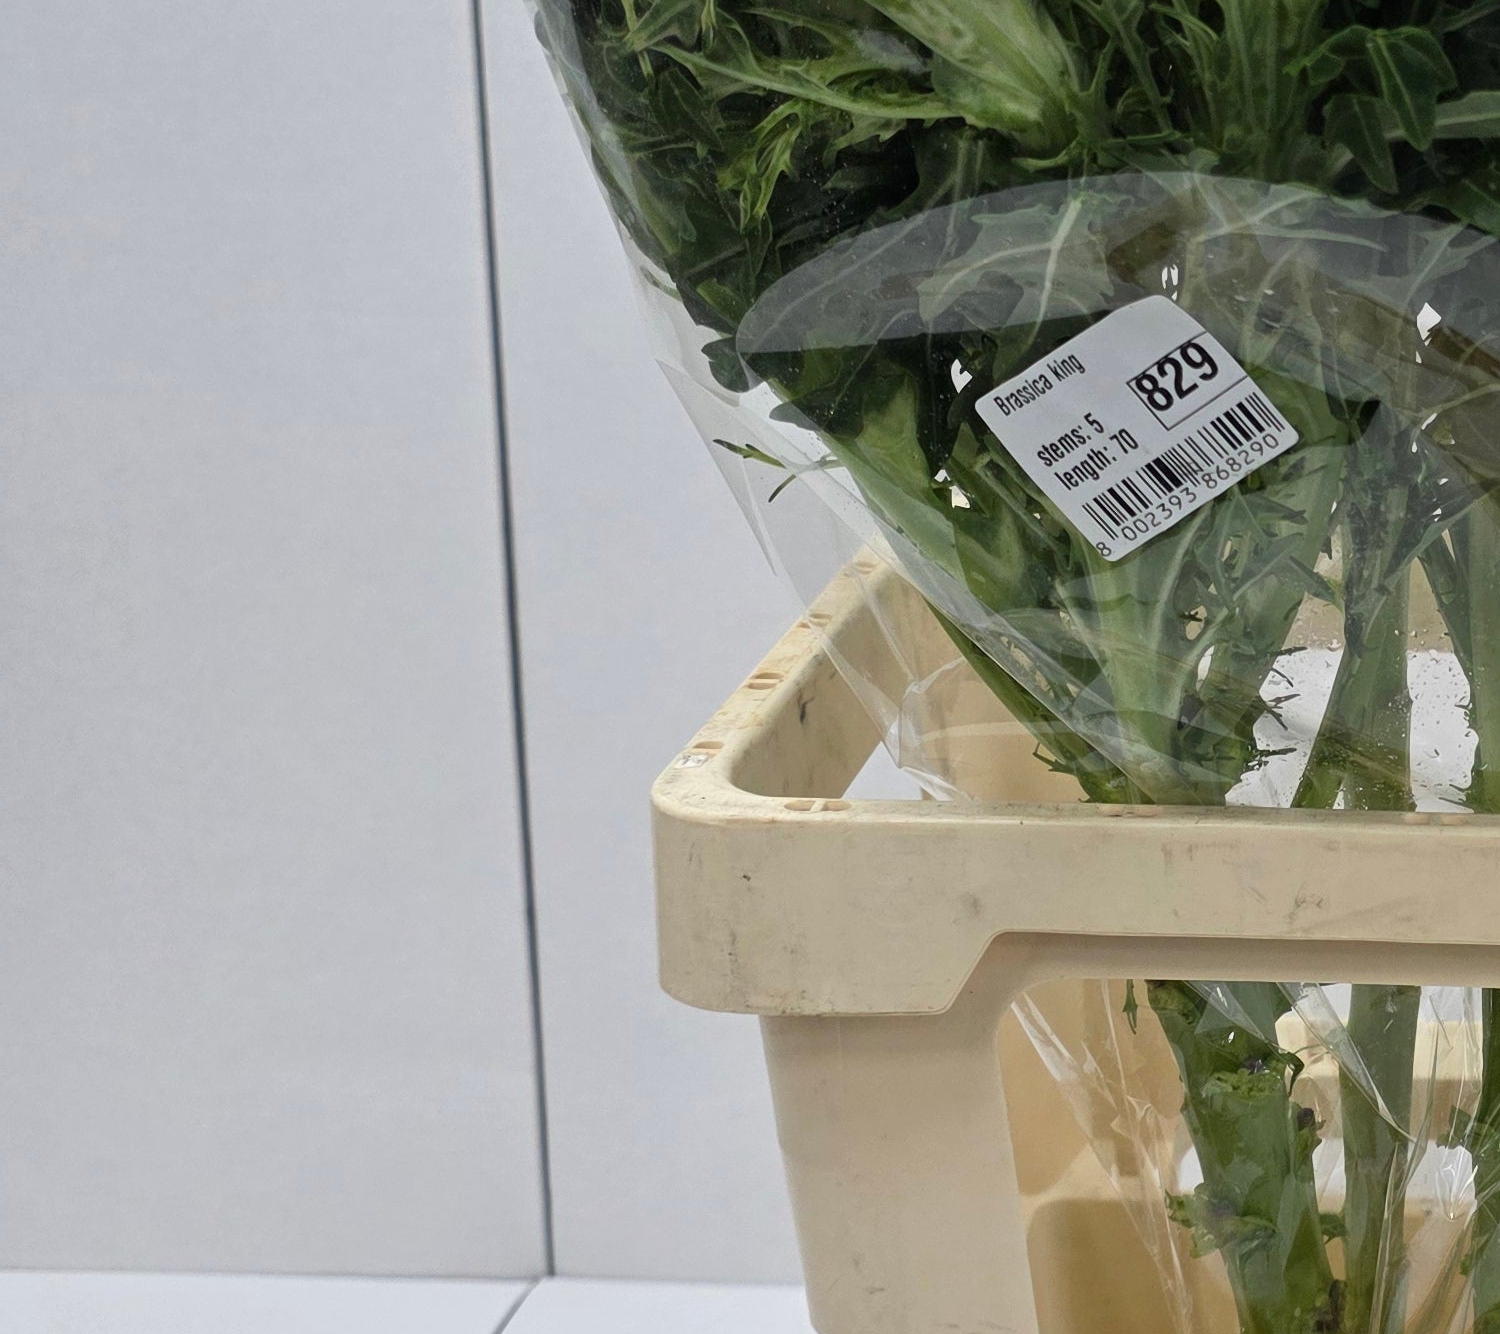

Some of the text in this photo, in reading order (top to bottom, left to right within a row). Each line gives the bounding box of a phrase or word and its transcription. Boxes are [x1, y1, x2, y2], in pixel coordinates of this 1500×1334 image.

[993, 375, 1053, 416] Brassica
[1135, 343, 1219, 411] 829
[1037, 412, 1105, 467] stems: 5
[1054, 428, 1139, 491] length: 70
[1096, 434, 1280, 558] 8 002393 868290
